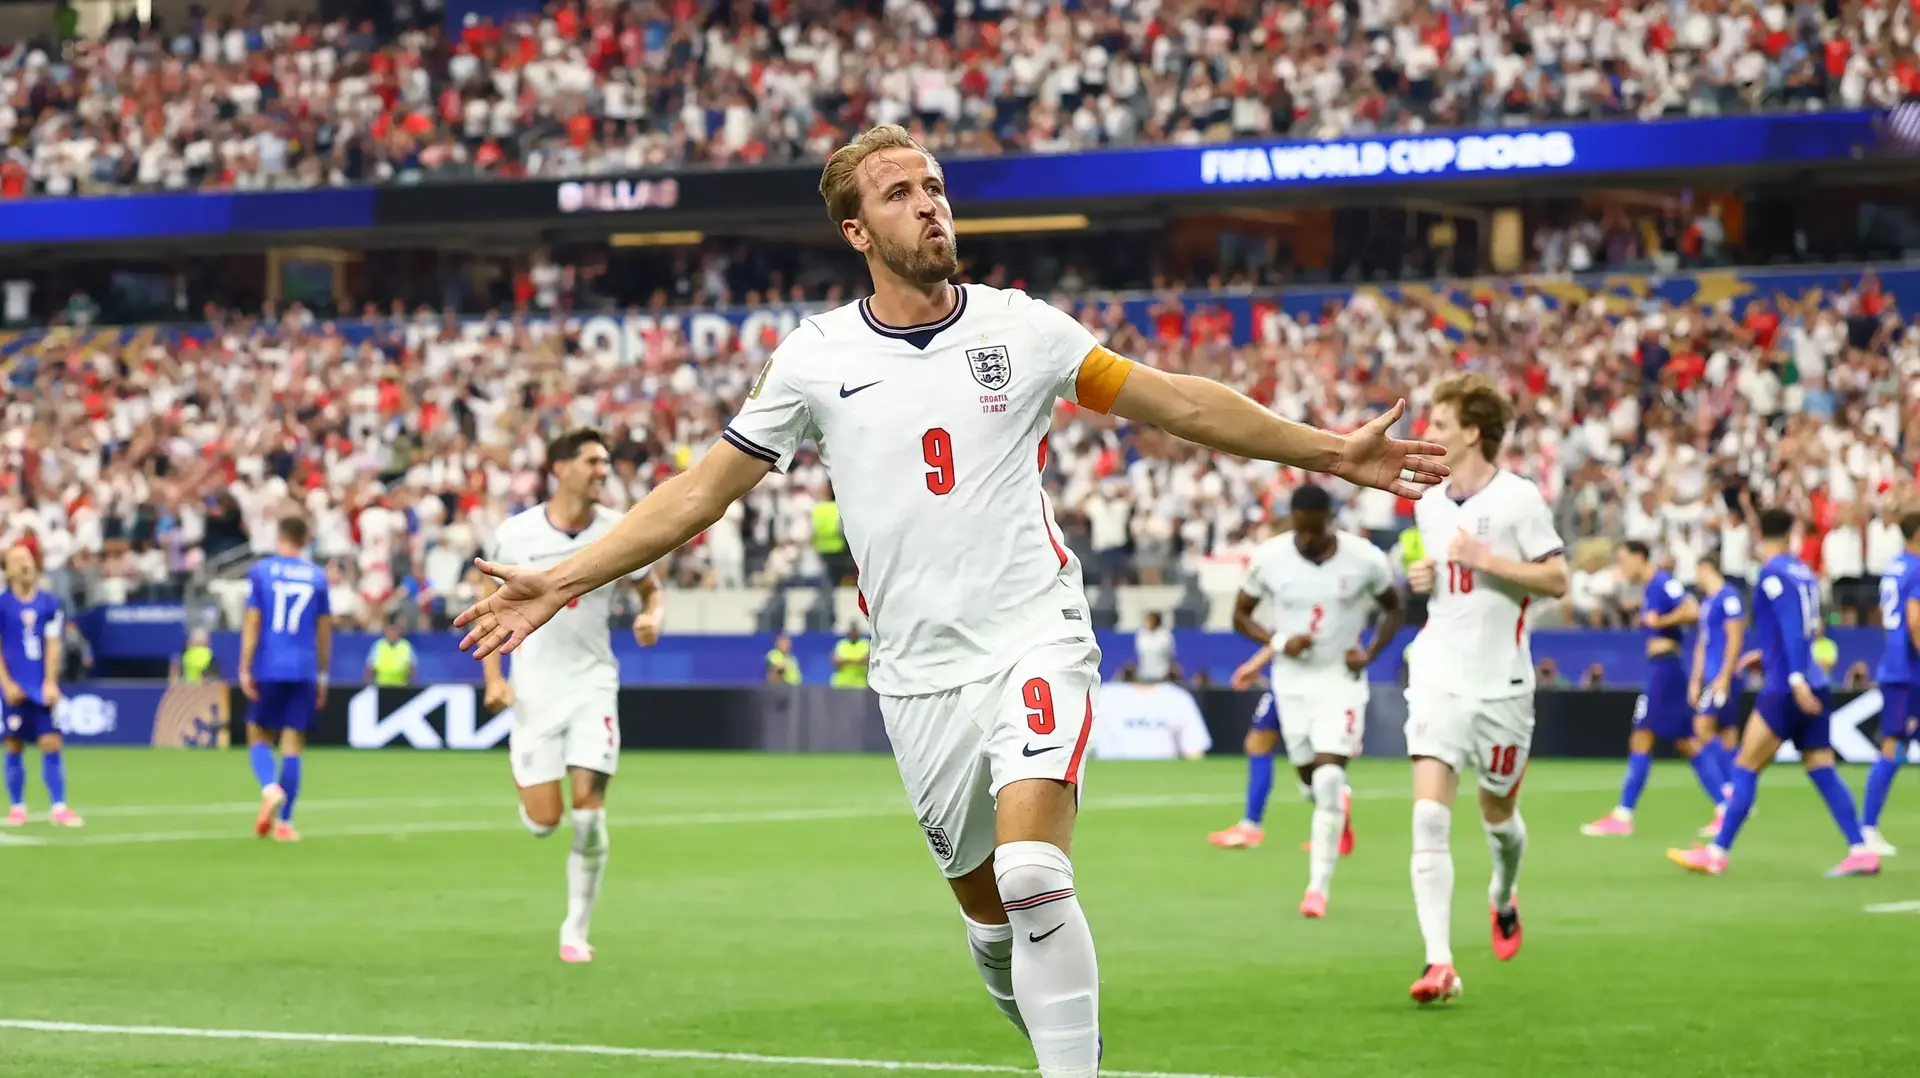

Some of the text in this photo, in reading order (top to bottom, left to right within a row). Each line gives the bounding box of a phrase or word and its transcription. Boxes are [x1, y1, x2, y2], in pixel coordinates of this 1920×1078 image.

[1201, 131, 1575, 183] FIFA WORLD CUP 2026
[979, 394, 1009, 404] CROATIA
[922, 427, 955, 496] 9
[272, 579, 314, 634] 17
[1310, 605, 1325, 635] 2
[1022, 676, 1056, 735] 9
[1490, 744, 1518, 776] 18
